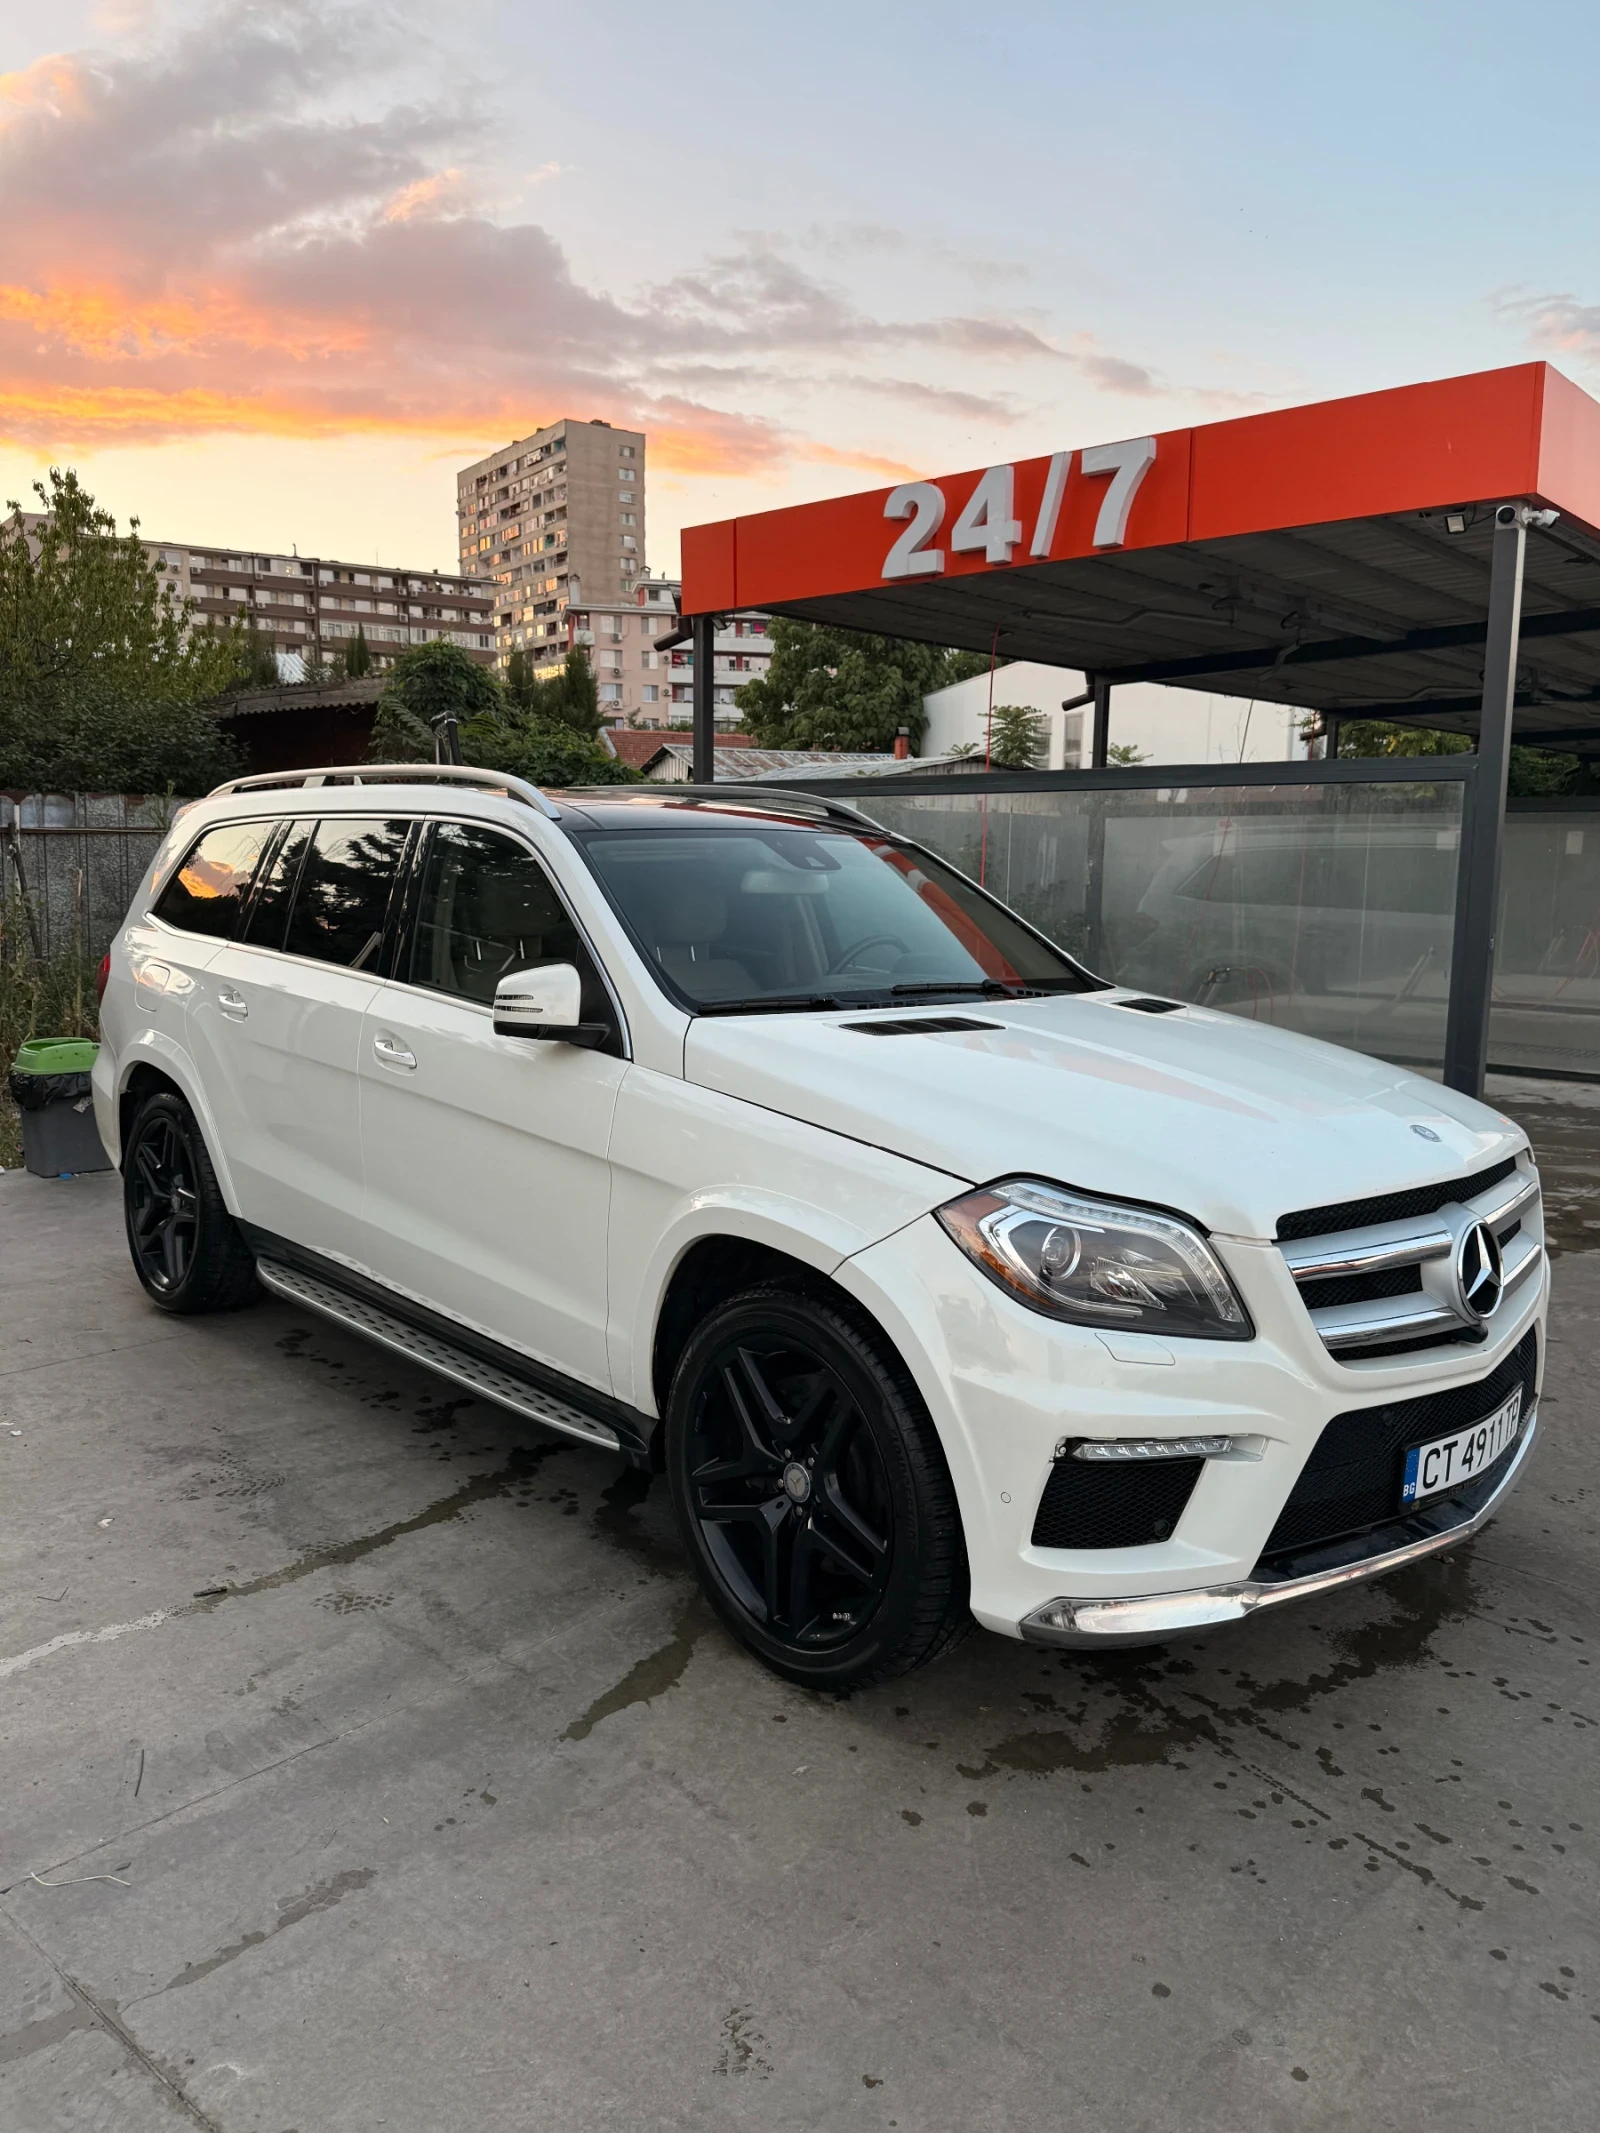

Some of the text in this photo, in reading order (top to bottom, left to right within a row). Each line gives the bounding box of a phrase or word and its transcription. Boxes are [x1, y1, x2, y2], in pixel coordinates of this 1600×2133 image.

[881, 436, 1156, 580] 24/7
[1423, 1396, 1518, 1489] CT 4911 TP
[1403, 1482, 1415, 1497] BG
